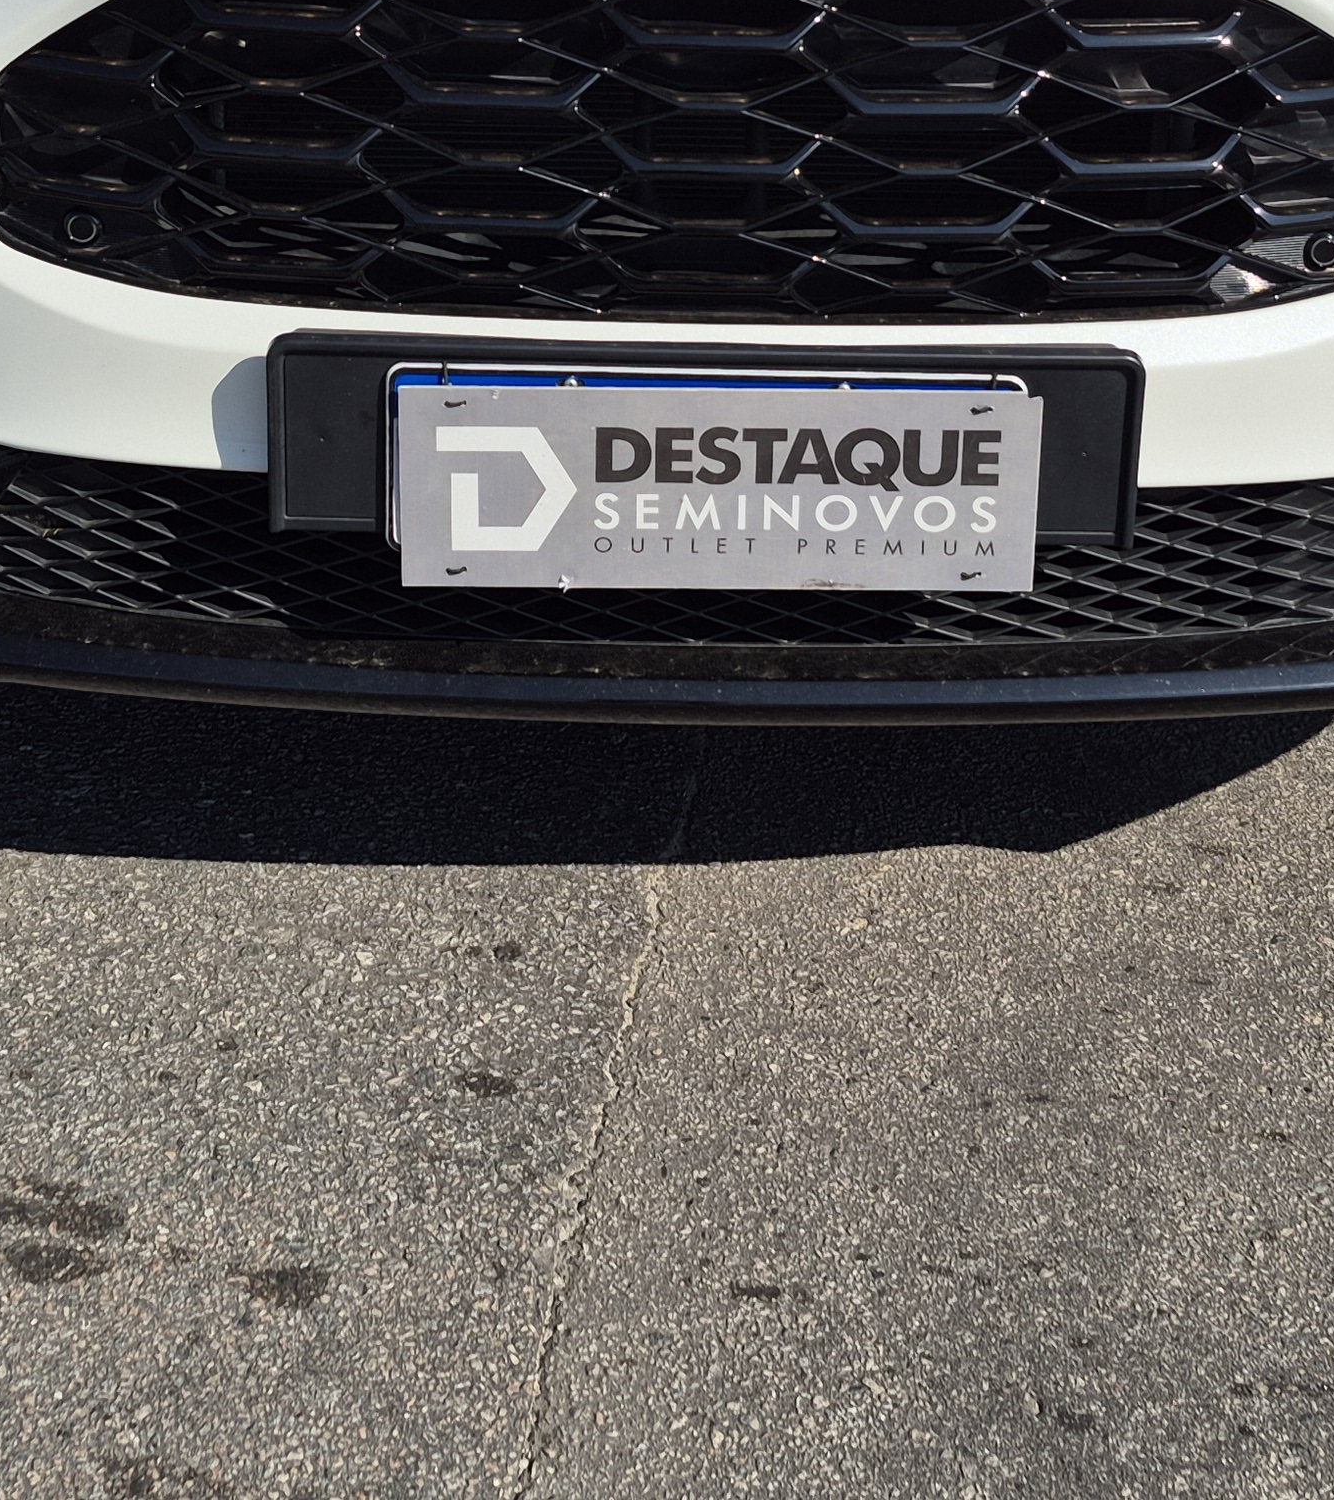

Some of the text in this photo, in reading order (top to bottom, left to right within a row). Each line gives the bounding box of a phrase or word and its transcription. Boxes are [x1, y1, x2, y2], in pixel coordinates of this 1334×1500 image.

[595, 426, 1002, 491] DESTAQUE
[593, 492, 997, 533] SEMINOVOS
[594, 536, 995, 556] OUTLET PREMIUM
